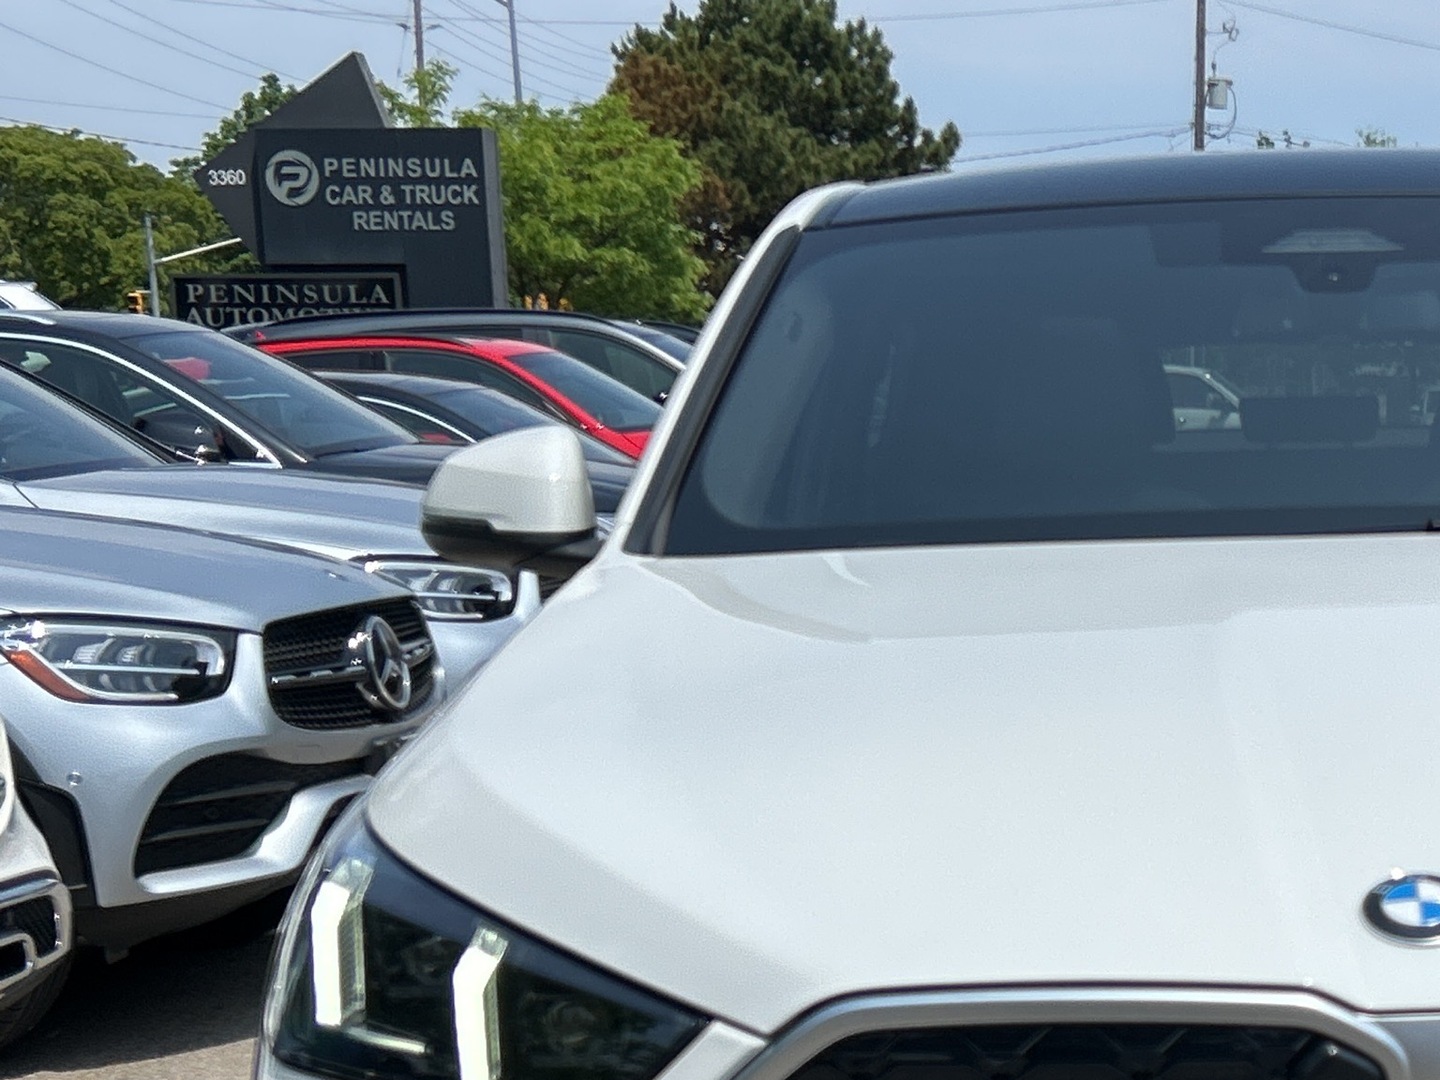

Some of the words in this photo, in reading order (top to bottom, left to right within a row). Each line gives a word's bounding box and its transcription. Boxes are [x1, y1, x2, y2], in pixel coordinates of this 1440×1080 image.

[208, 169, 246, 187] 3360
[323, 157, 478, 179] PENINSULA
[325, 185, 374, 206] CAR
[379, 186, 396, 206] &
[401, 185, 480, 206] TRUCK
[353, 210, 455, 231] RENTALS
[186, 283, 391, 305] PENINSULA
